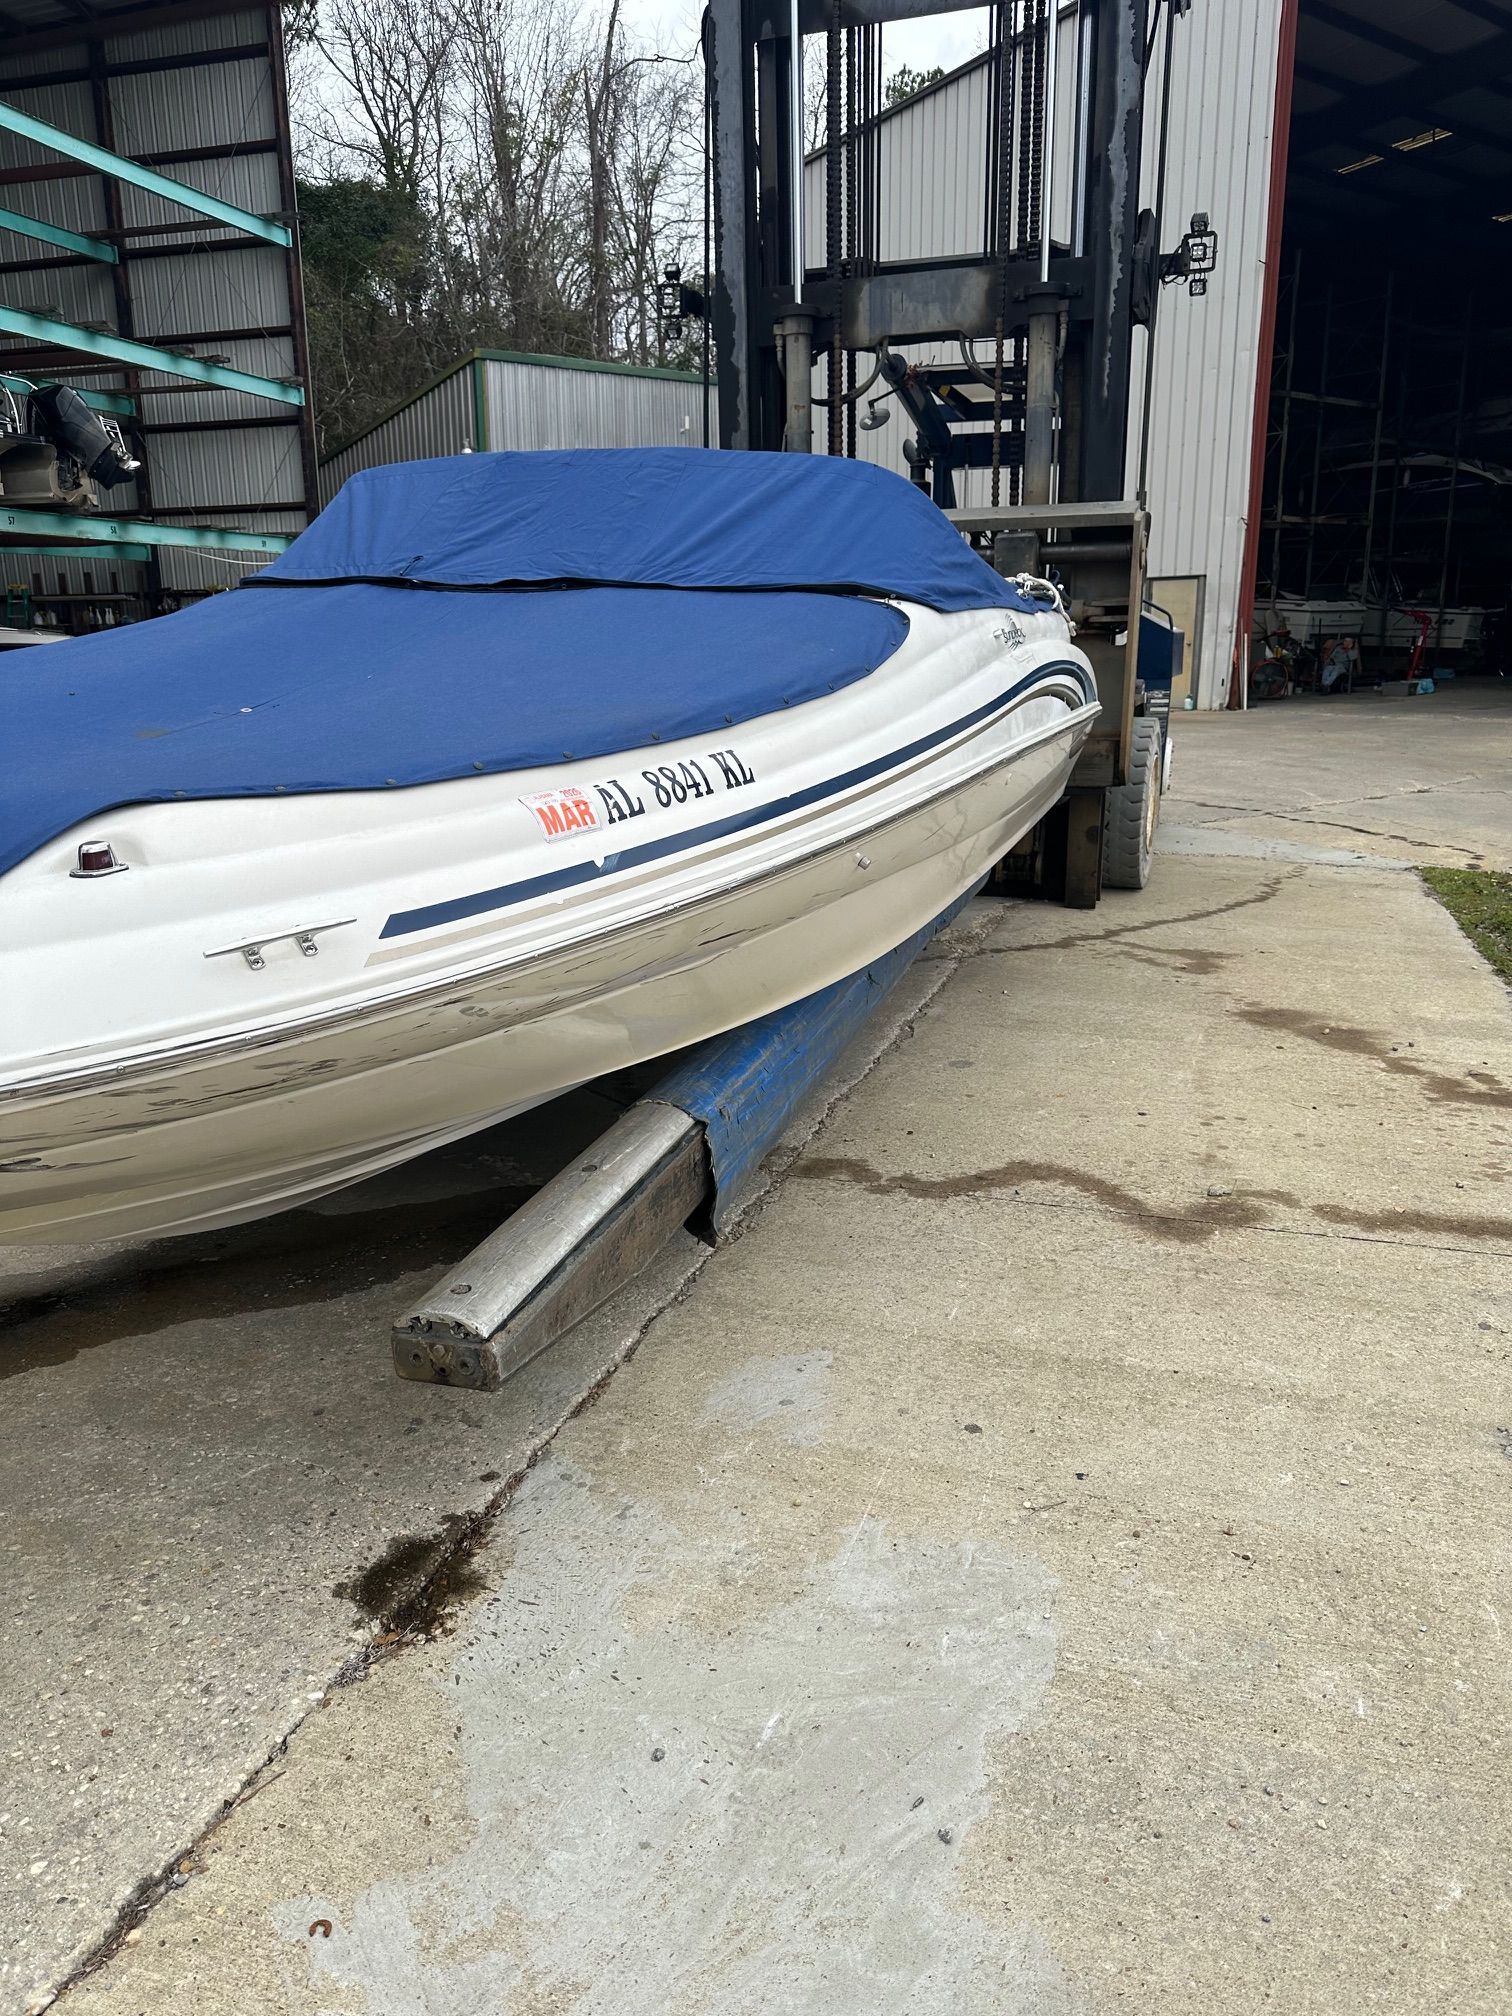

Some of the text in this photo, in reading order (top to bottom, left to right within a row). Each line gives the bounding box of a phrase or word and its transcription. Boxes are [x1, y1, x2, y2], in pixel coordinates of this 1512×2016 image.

[593, 749, 756, 825] AL 8841 KL
[535, 799, 597, 836] MAR
